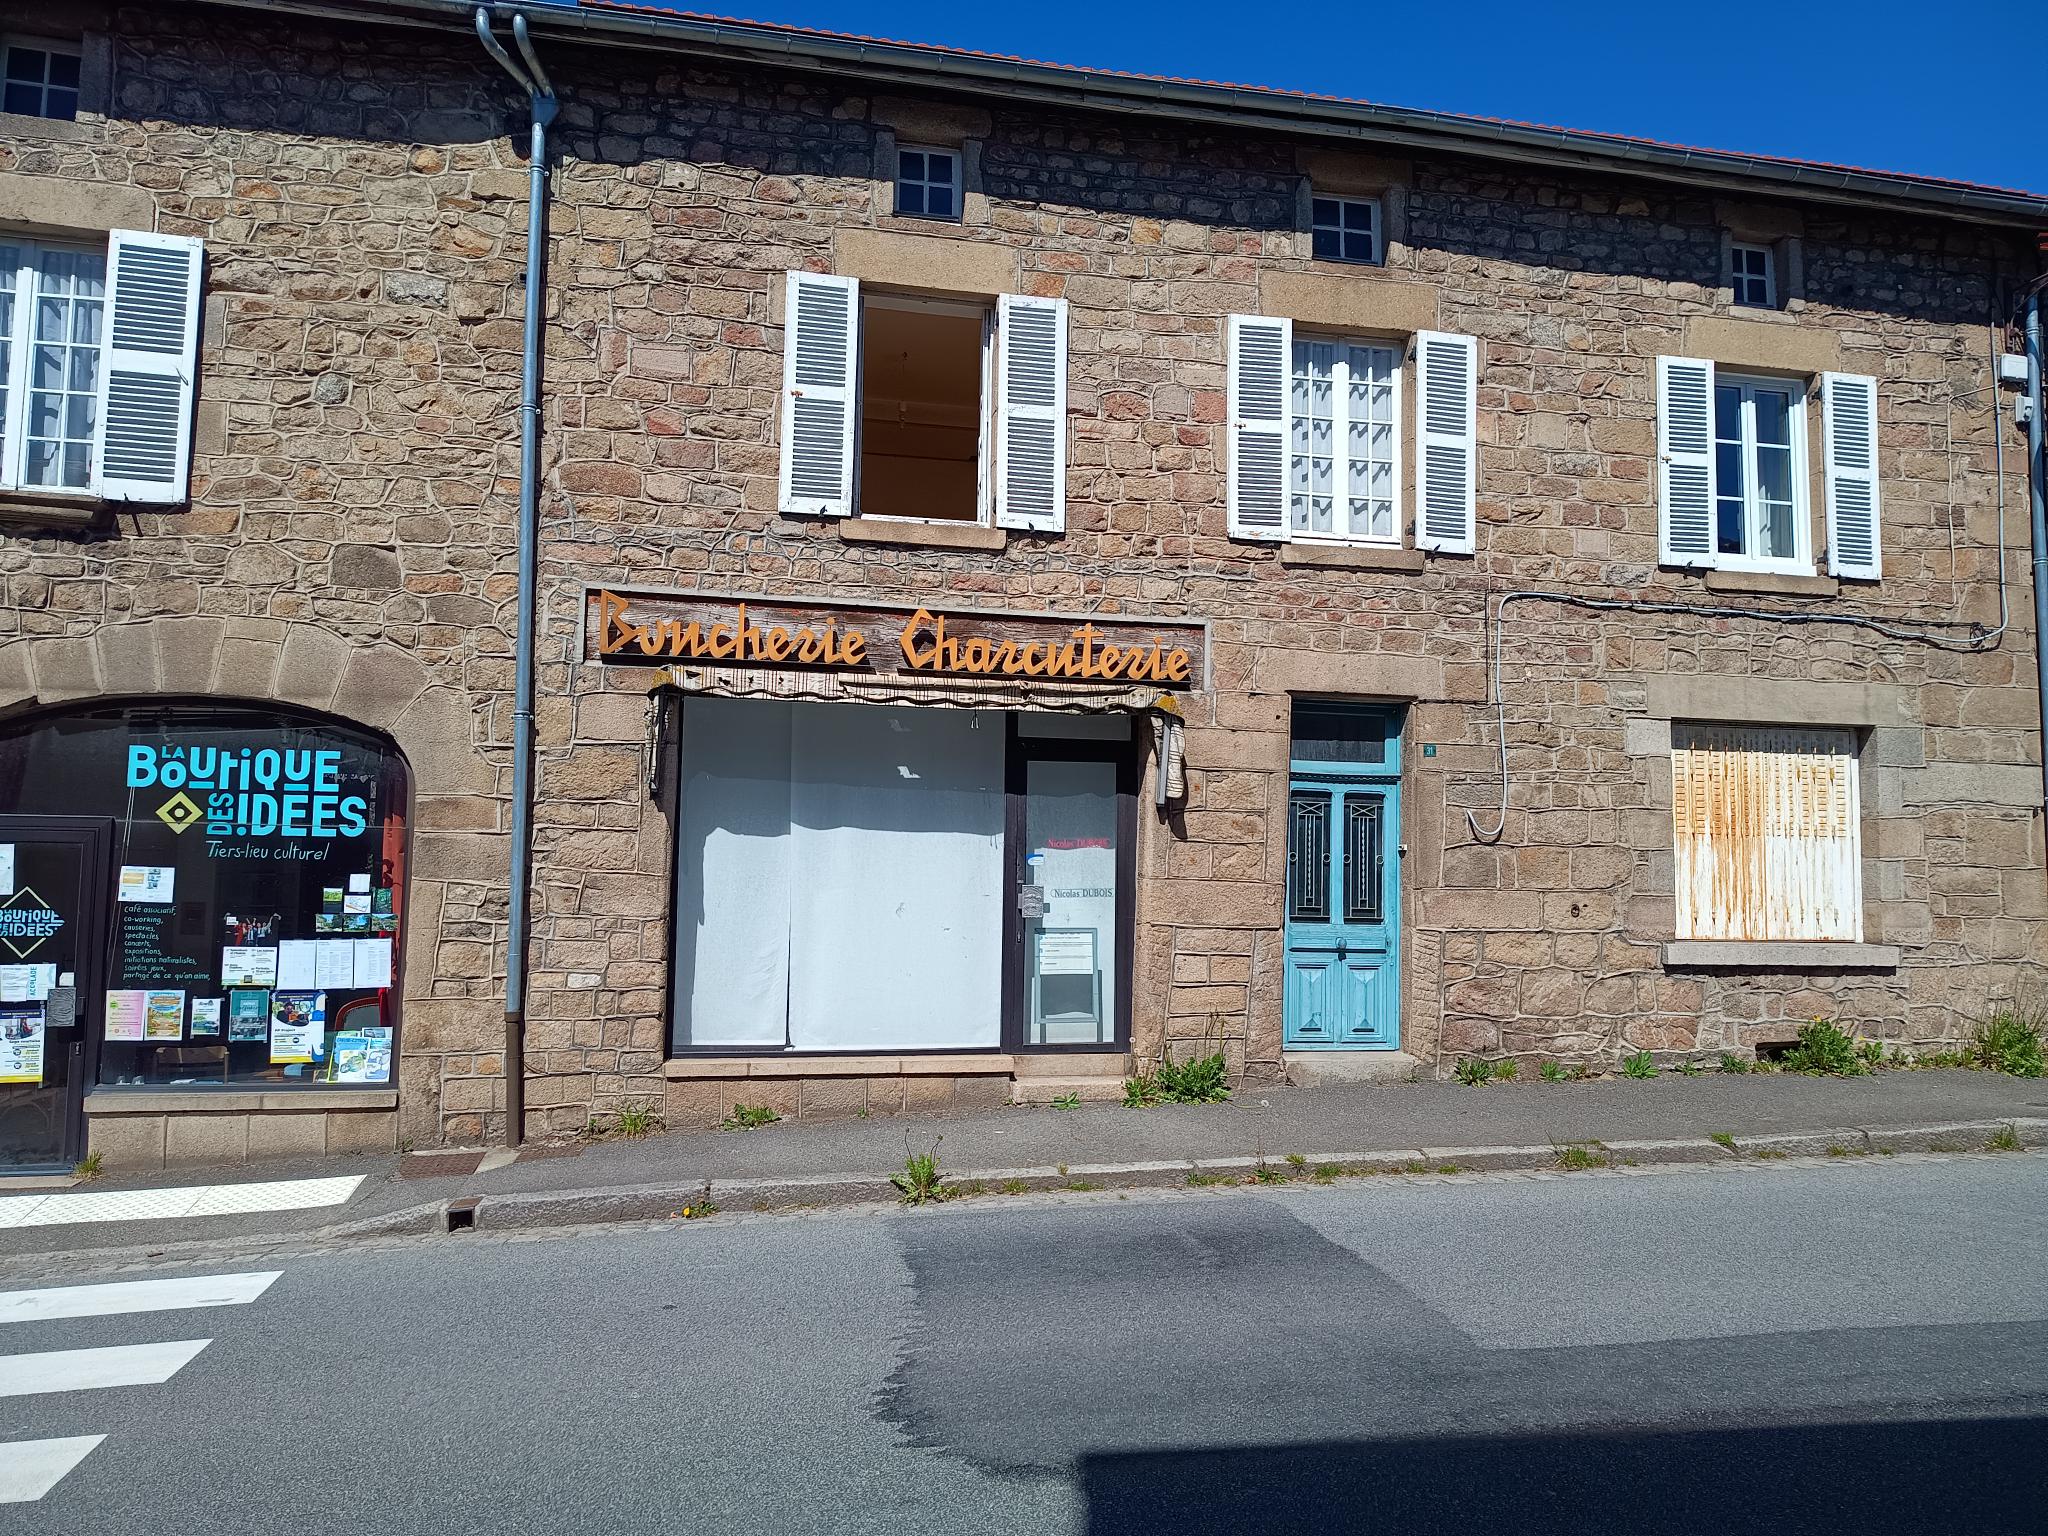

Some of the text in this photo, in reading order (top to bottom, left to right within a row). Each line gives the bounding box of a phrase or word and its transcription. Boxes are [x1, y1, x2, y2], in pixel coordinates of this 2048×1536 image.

[600, 589, 1191, 681] Boucherie Charcuterie
[161, 746, 185, 759] LA
[1426, 746, 1433, 755] 31
[206, 792, 234, 836] DES
[205, 840, 330, 860] Tiers-lieu culturel
[1054, 888, 1113, 898] Nicolas DUBOIS
[123, 917, 163, 925] co-working,
